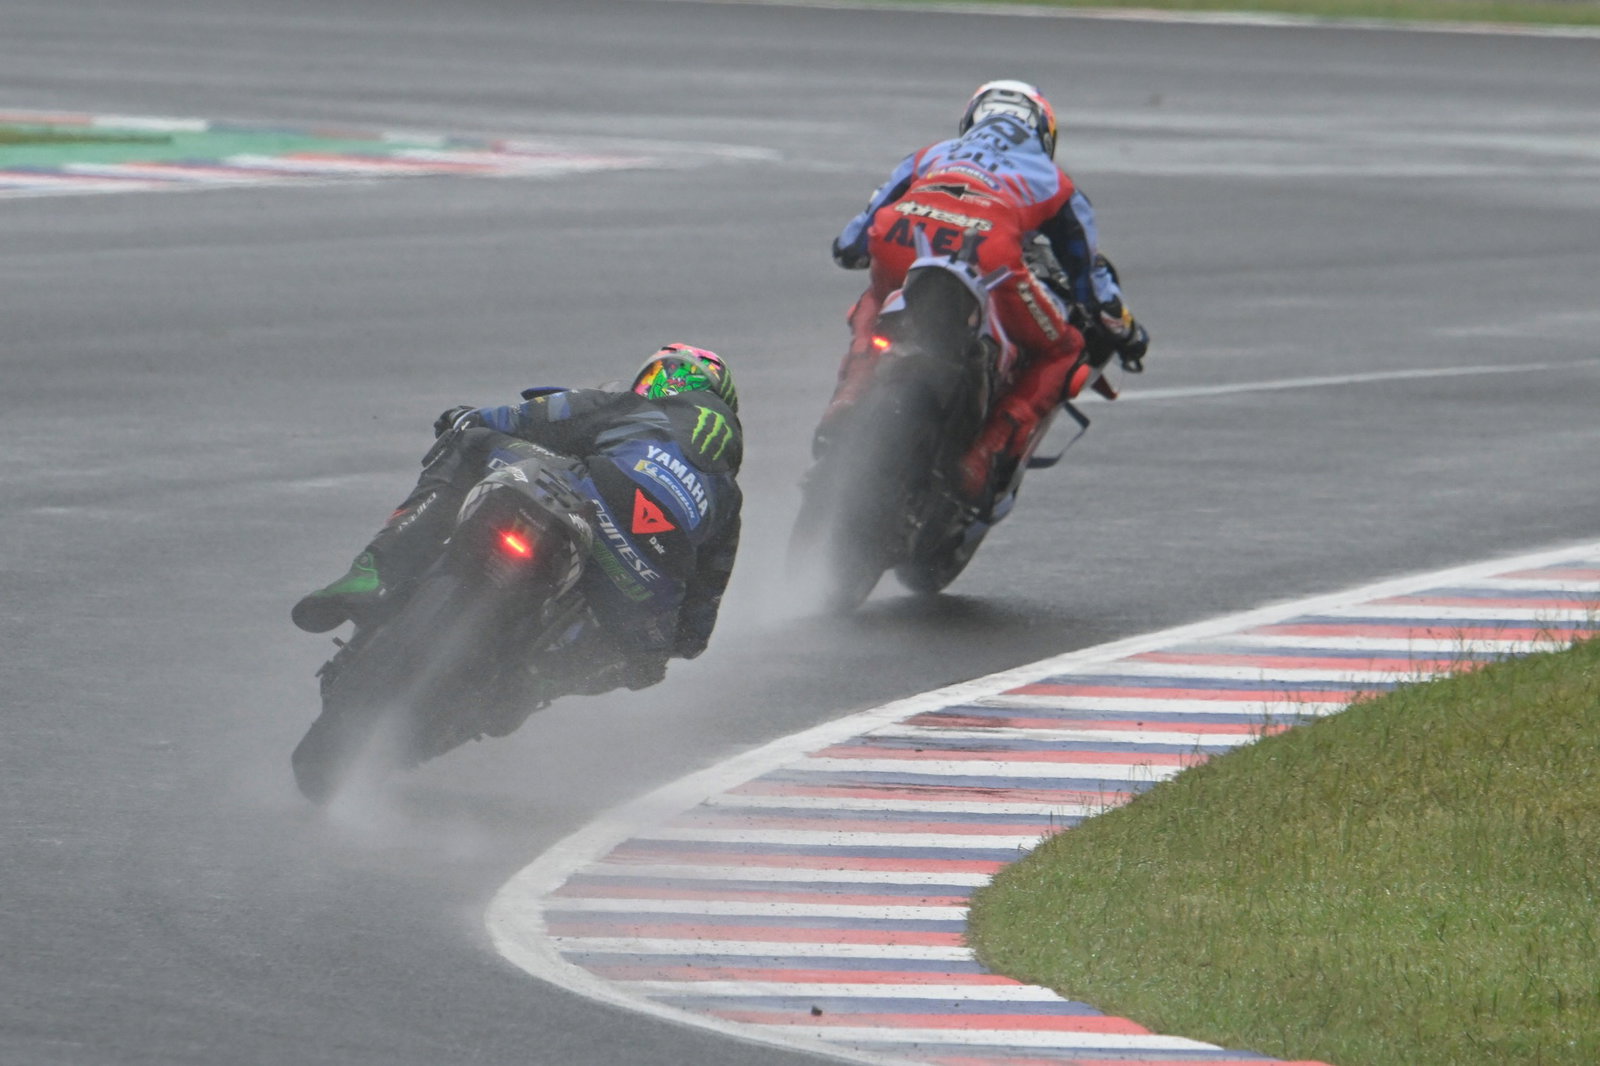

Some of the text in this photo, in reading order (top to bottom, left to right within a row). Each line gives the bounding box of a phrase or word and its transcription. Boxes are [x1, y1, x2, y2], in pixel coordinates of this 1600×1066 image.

[647, 446, 708, 516] YAMAHA
[659, 474, 695, 518] MICHELIN
[592, 499, 660, 582] DAINESE
